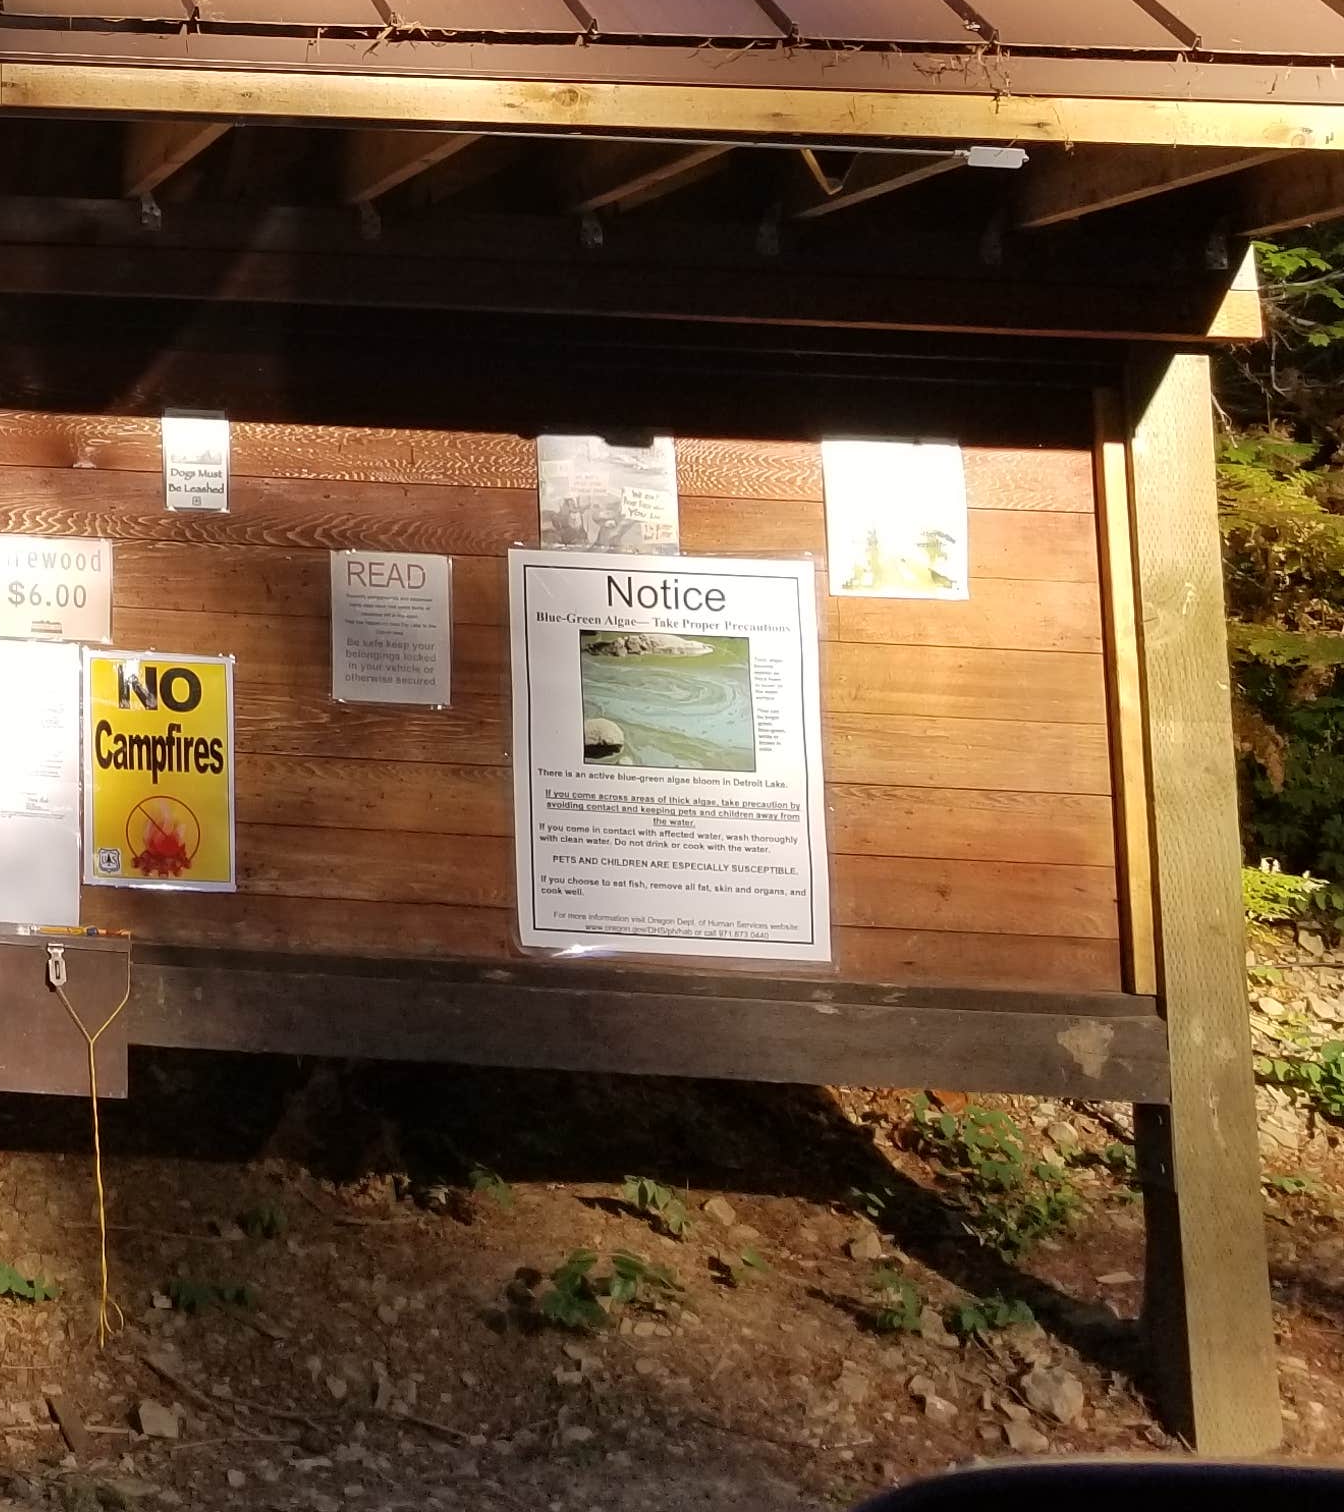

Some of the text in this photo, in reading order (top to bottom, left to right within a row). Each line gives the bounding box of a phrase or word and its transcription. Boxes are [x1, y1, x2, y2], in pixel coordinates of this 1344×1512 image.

[171, 468, 222, 480] Dogs Must
[169, 482, 224, 493] Be Leashed
[3, 549, 101, 572] rewood
[347, 561, 426, 589] READ
[8, 580, 86, 608] $6.00
[606, 575, 726, 612] Notice
[536, 611, 601, 625] Blue-Green
[653, 617, 678, 629] Take
[683, 619, 719, 631] Proper
[724, 621, 791, 632] Precautions
[362, 639, 383, 647] safe
[386, 640, 409, 650] keep
[412, 643, 435, 651] your
[346, 650, 436, 662] belongings locked
[361, 663, 382, 672] your
[385, 664, 420, 673] vehicle
[345, 673, 436, 685] otherwise secured
[118, 664, 202, 712] NO
[95, 720, 224, 784] Campfires
[538, 769, 563, 777] There
[589, 771, 614, 780] active
[618, 772, 664, 783] blue-green
[667, 776, 690, 785] algae
[693, 777, 720, 785] bloom
[734, 779, 763, 787] Detroit
[546, 802, 583, 810] avoiding
[586, 803, 619, 812] contact
[641, 807, 675, 816] keeping
[719, 810, 753, 818] children
[756, 812, 778, 820] away
[780, 812, 800, 820] from
[743, 800, 788, 809] precaution
[790, 802, 800, 810] by
[653, 817, 667, 825] the
[601, 858, 648, 867] CHILDREN
[672, 862, 729, 872] ESPECIALLY
